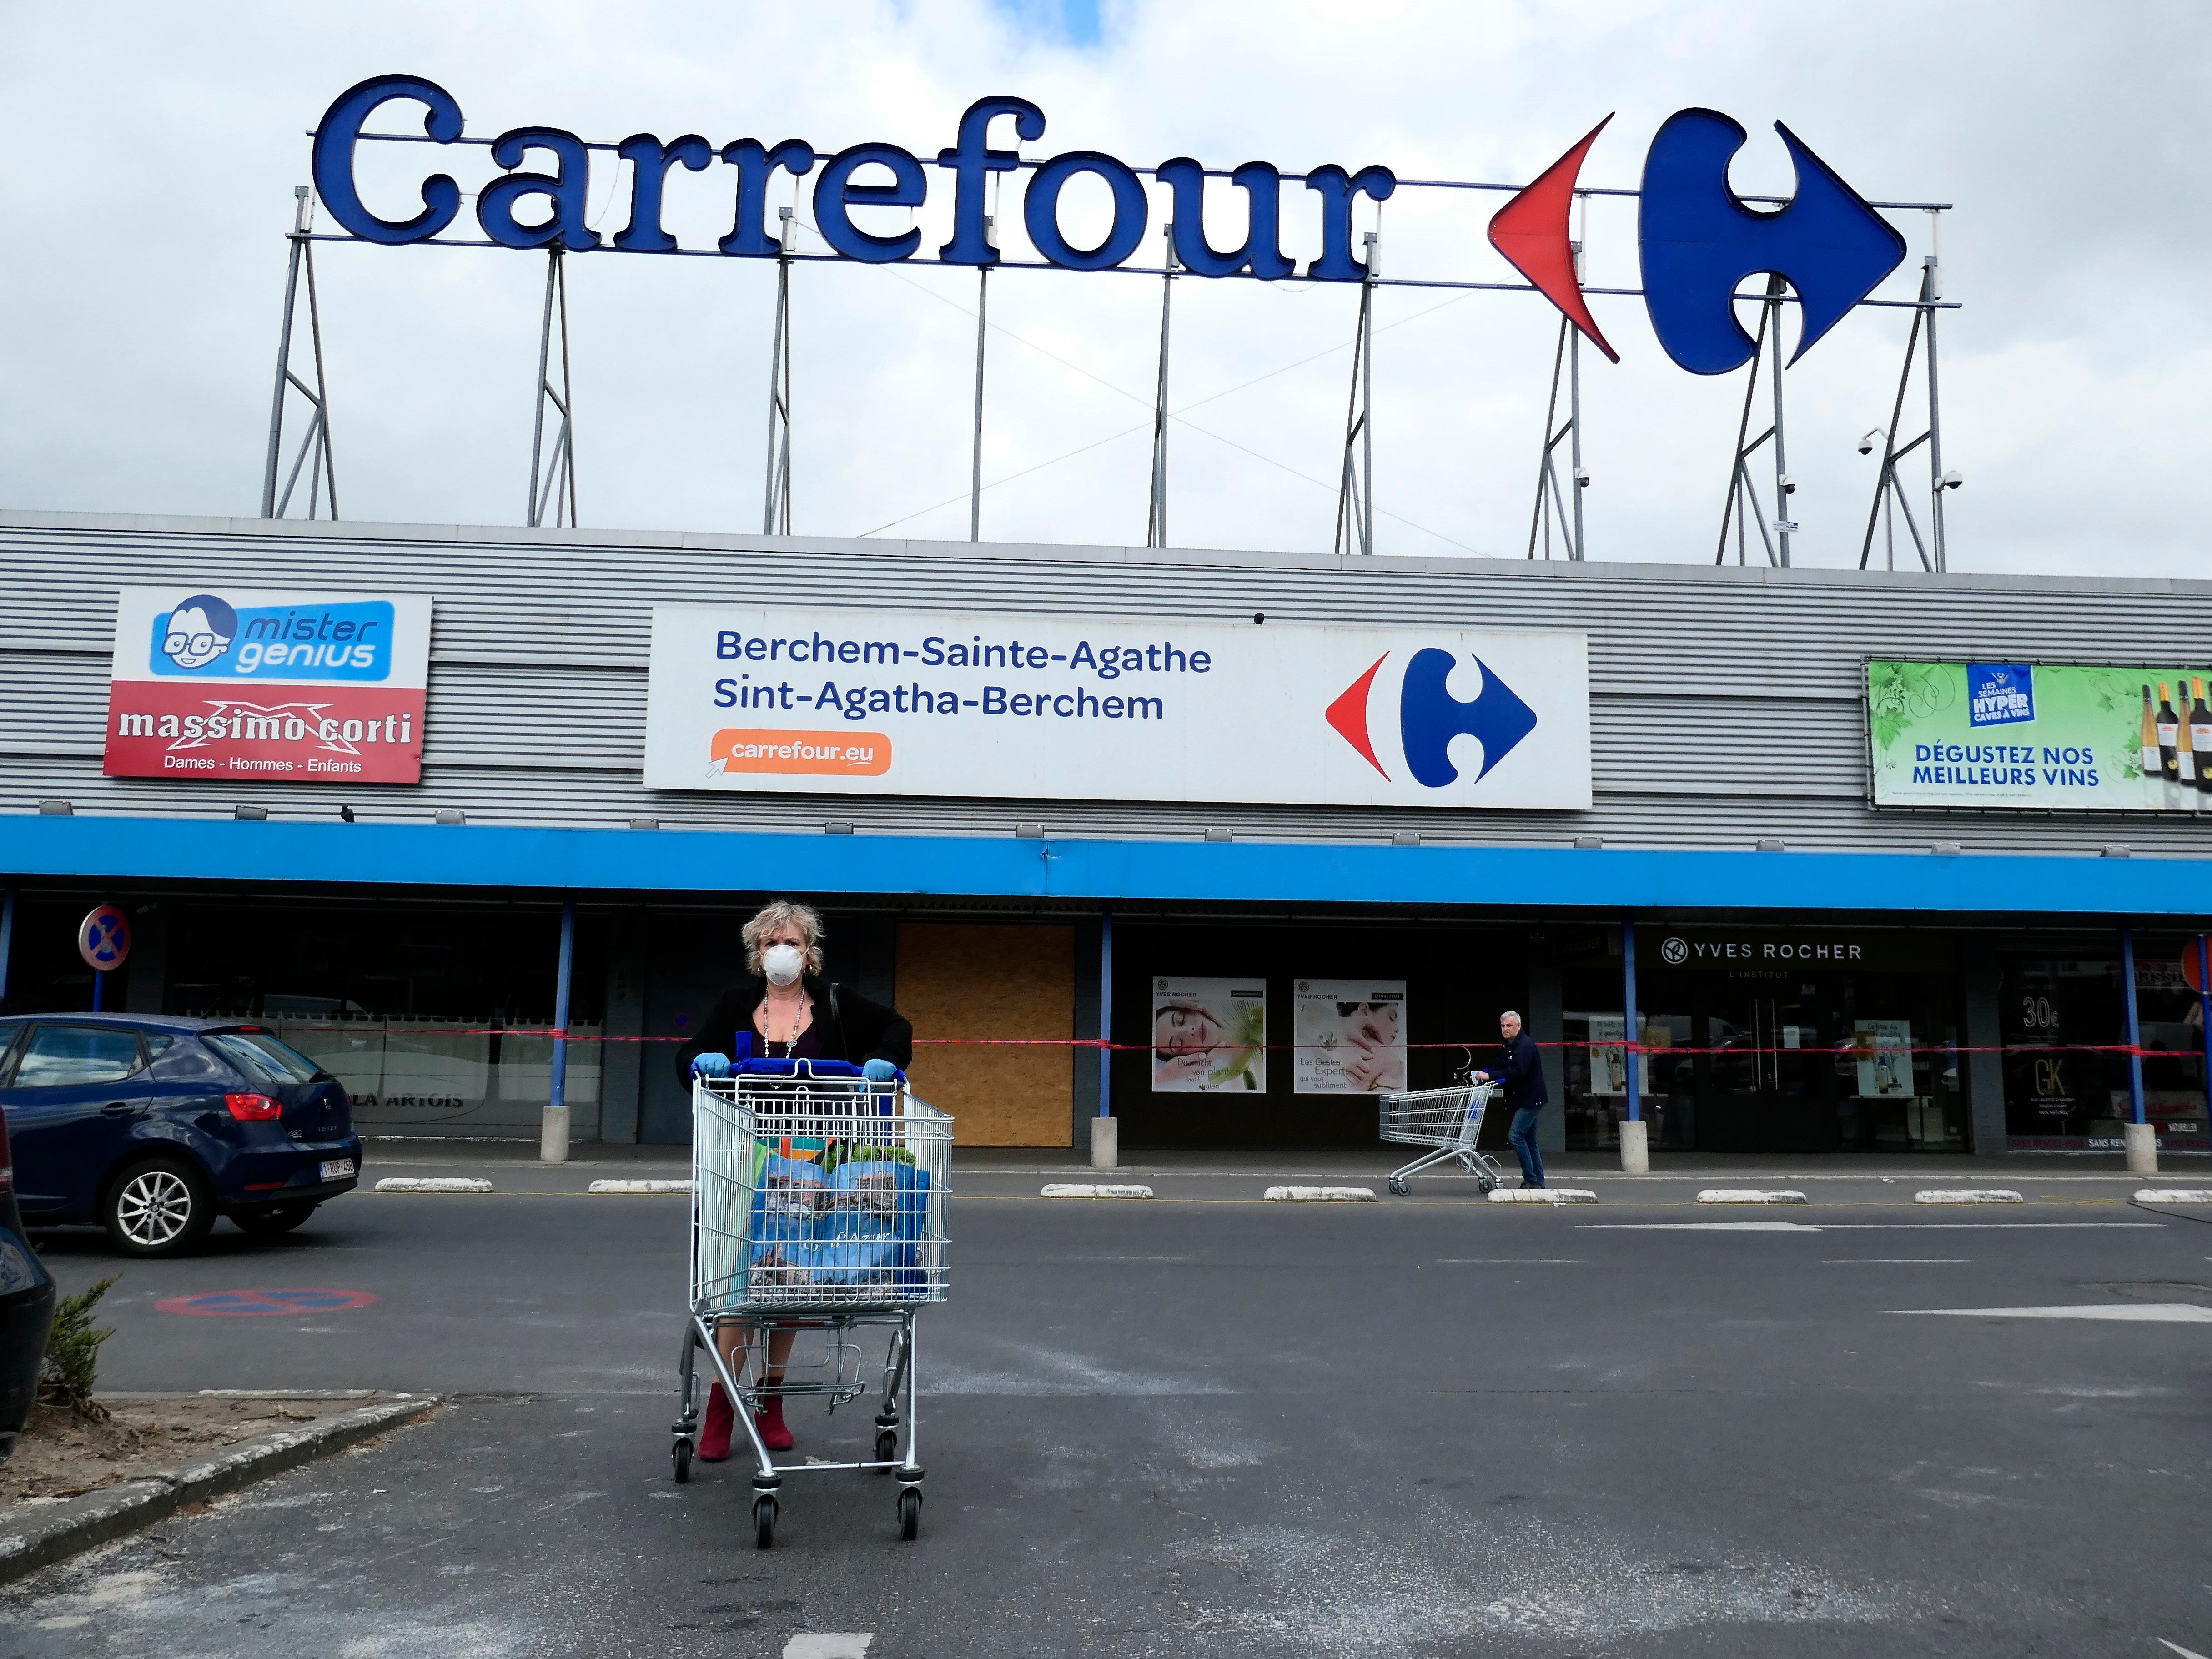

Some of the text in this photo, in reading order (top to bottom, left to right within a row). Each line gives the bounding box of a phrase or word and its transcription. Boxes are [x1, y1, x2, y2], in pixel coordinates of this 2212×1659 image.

[312, 73, 1396, 280] Carrefour
[244, 611, 378, 641] mister
[235, 642, 376, 673] genius
[716, 631, 1212, 679] Berchem-Sainte-Agathe
[713, 675, 1164, 720] Sint-Agatha-Berchem
[1978, 687, 2016, 698] SEMAINES
[1973, 693, 2028, 713] HYPER
[1974, 711, 2002, 722] CAVES
[2010, 708, 2030, 718] VINS
[118, 709, 412, 743] massimo corti
[731, 741, 874, 762] carrefour.eu
[1915, 739, 2093, 764] DÉGUSTEZ NOS
[164, 755, 215, 769] Dames
[229, 757, 293, 771] Hommes
[308, 759, 362, 773] Enfants
[1913, 766, 2099, 787] MEILLEURS VINS
[1694, 943, 1862, 959] YVES ROCHER
[1729, 970, 1789, 979] L'INSTITUT
[1189, 1058, 1212, 1066] kracht
[1315, 1066, 1349, 1076] Experts
[1207, 1067, 1241, 1078] planten
[386, 1094, 463, 1108] ARTOIS
